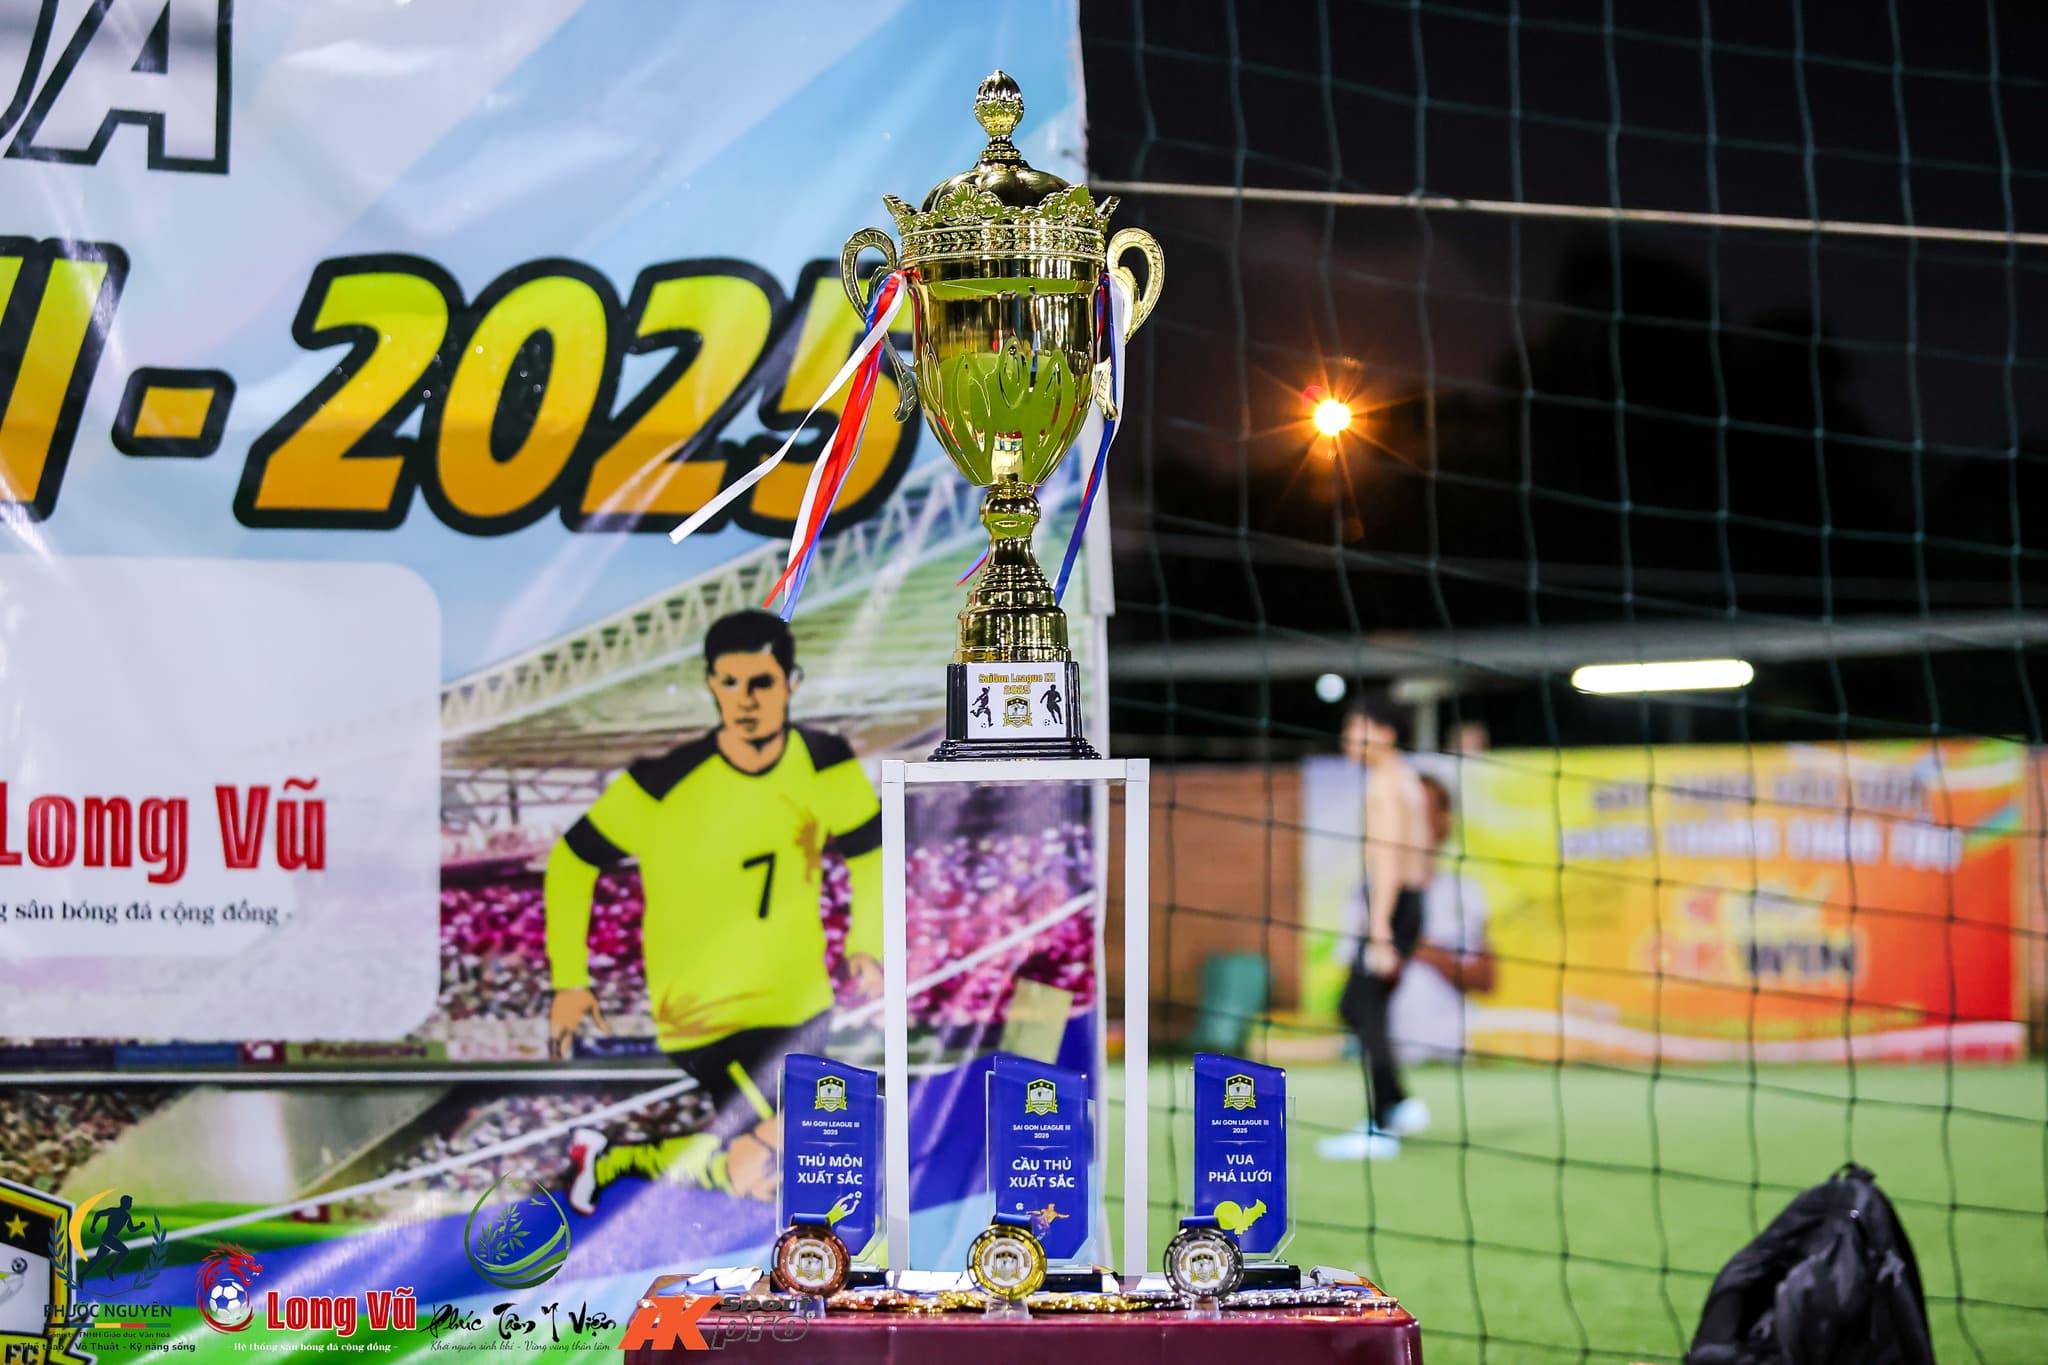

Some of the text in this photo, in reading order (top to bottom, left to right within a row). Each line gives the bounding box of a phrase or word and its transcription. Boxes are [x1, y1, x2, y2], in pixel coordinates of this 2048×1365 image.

[233, 255, 920, 536] 2025
[1011, 673, 1043, 684] League
[214, 777, 327, 871] Vũ
[742, 852, 776, 919] 7
[15, 899, 54, 920] sân
[62, 901, 118, 923] bóng
[125, 901, 152, 920] đá
[160, 903, 214, 925] cộng
[222, 899, 278, 925] đồng
[797, 1153, 863, 1168] THỦ MÔN
[1012, 1156, 1072, 1171] CẦU THỦ
[1226, 1154, 1254, 1165] VUA
[797, 1170, 863, 1185] XUẤT SẮC
[1009, 1173, 1075, 1188] XUẤT SẮC
[1208, 1168, 1272, 1182] PHÁ LƯỚI
[5, 1343, 39, 1365] FC
